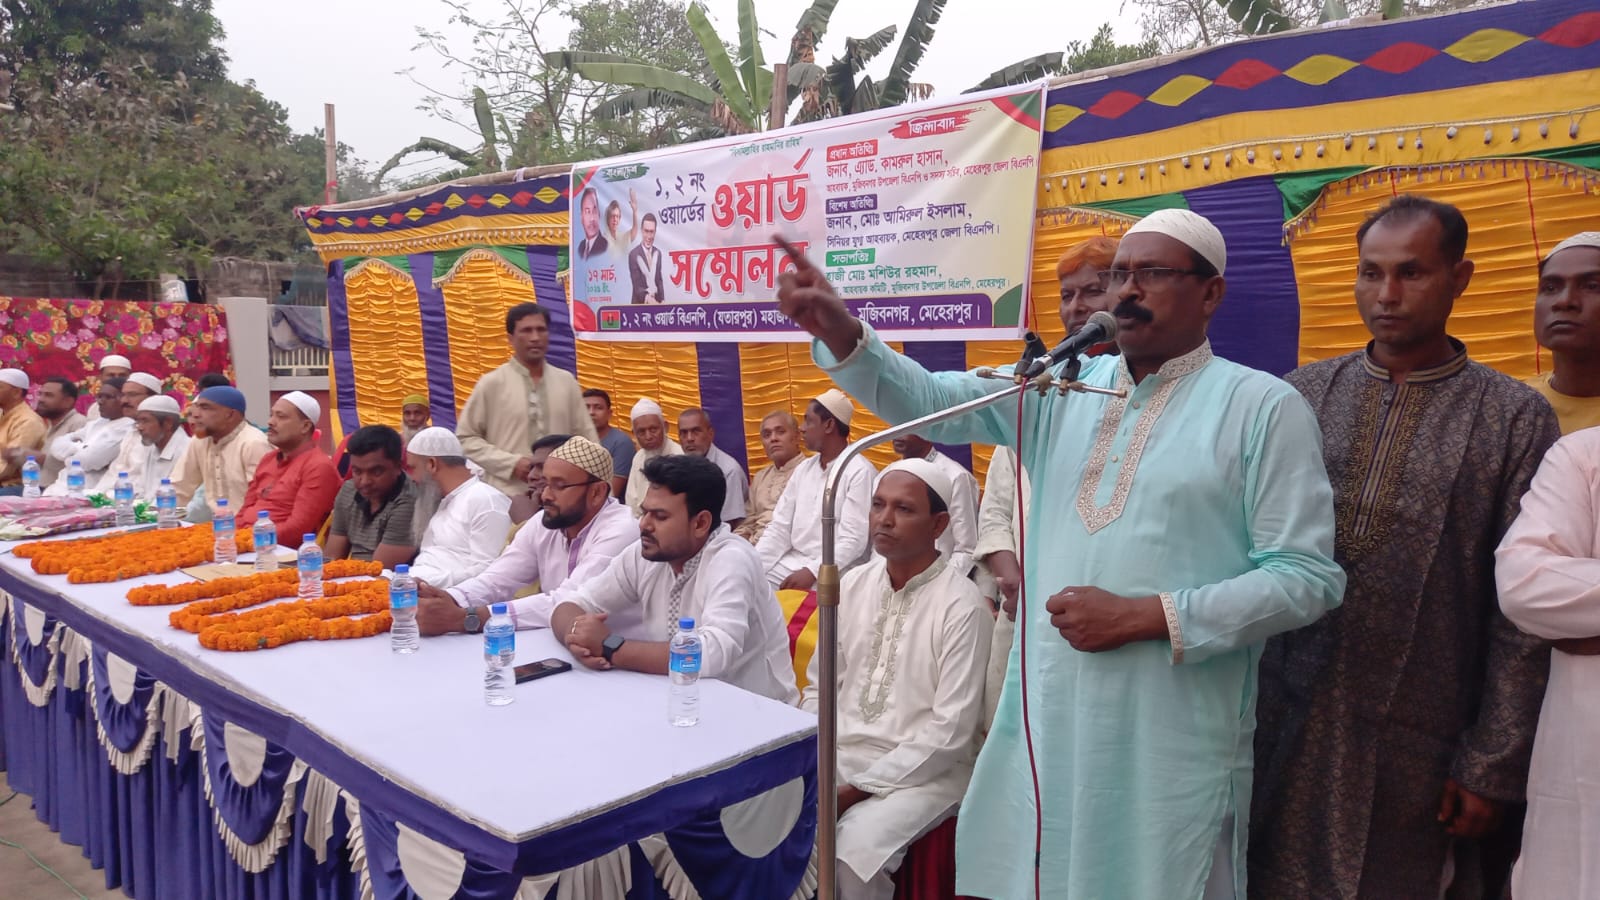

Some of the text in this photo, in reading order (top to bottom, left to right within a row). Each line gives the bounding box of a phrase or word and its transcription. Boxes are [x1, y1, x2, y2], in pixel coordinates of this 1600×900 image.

[606, 165, 637, 179] বাংলাদেশ
[827, 163, 851, 178] জনাব,
[881, 154, 913, 170] কামরুল
[916, 149, 948, 166] হাসান,
[675, 175, 684, 196] ২
[689, 172, 706, 192] নং
[711, 147, 809, 230] ওয়ার্ড
[659, 196, 706, 225] ওয়ার্ডের
[826, 202, 972, 231] জনাব, মোঃ আমিরুল ইসলাম,
[828, 200, 848, 212] বিশেষ
[827, 235, 850, 248] সিনিয়র
[902, 229, 937, 242] মেহেরপুর
[941, 227, 961, 239] জেলা
[832, 251, 869, 264] সভাপতিঃ
[588, 269, 599, 282] ১৭
[826, 265, 942, 281] হাজী মোঃ মশিউর রহমান,
[634, 313, 640, 327] ২
[641, 312, 652, 327] নং
[655, 307, 676, 326] ওয়ার্ড
[677, 307, 710, 328] বিএনপি,
[857, 301, 915, 325] মজিবনগর,
